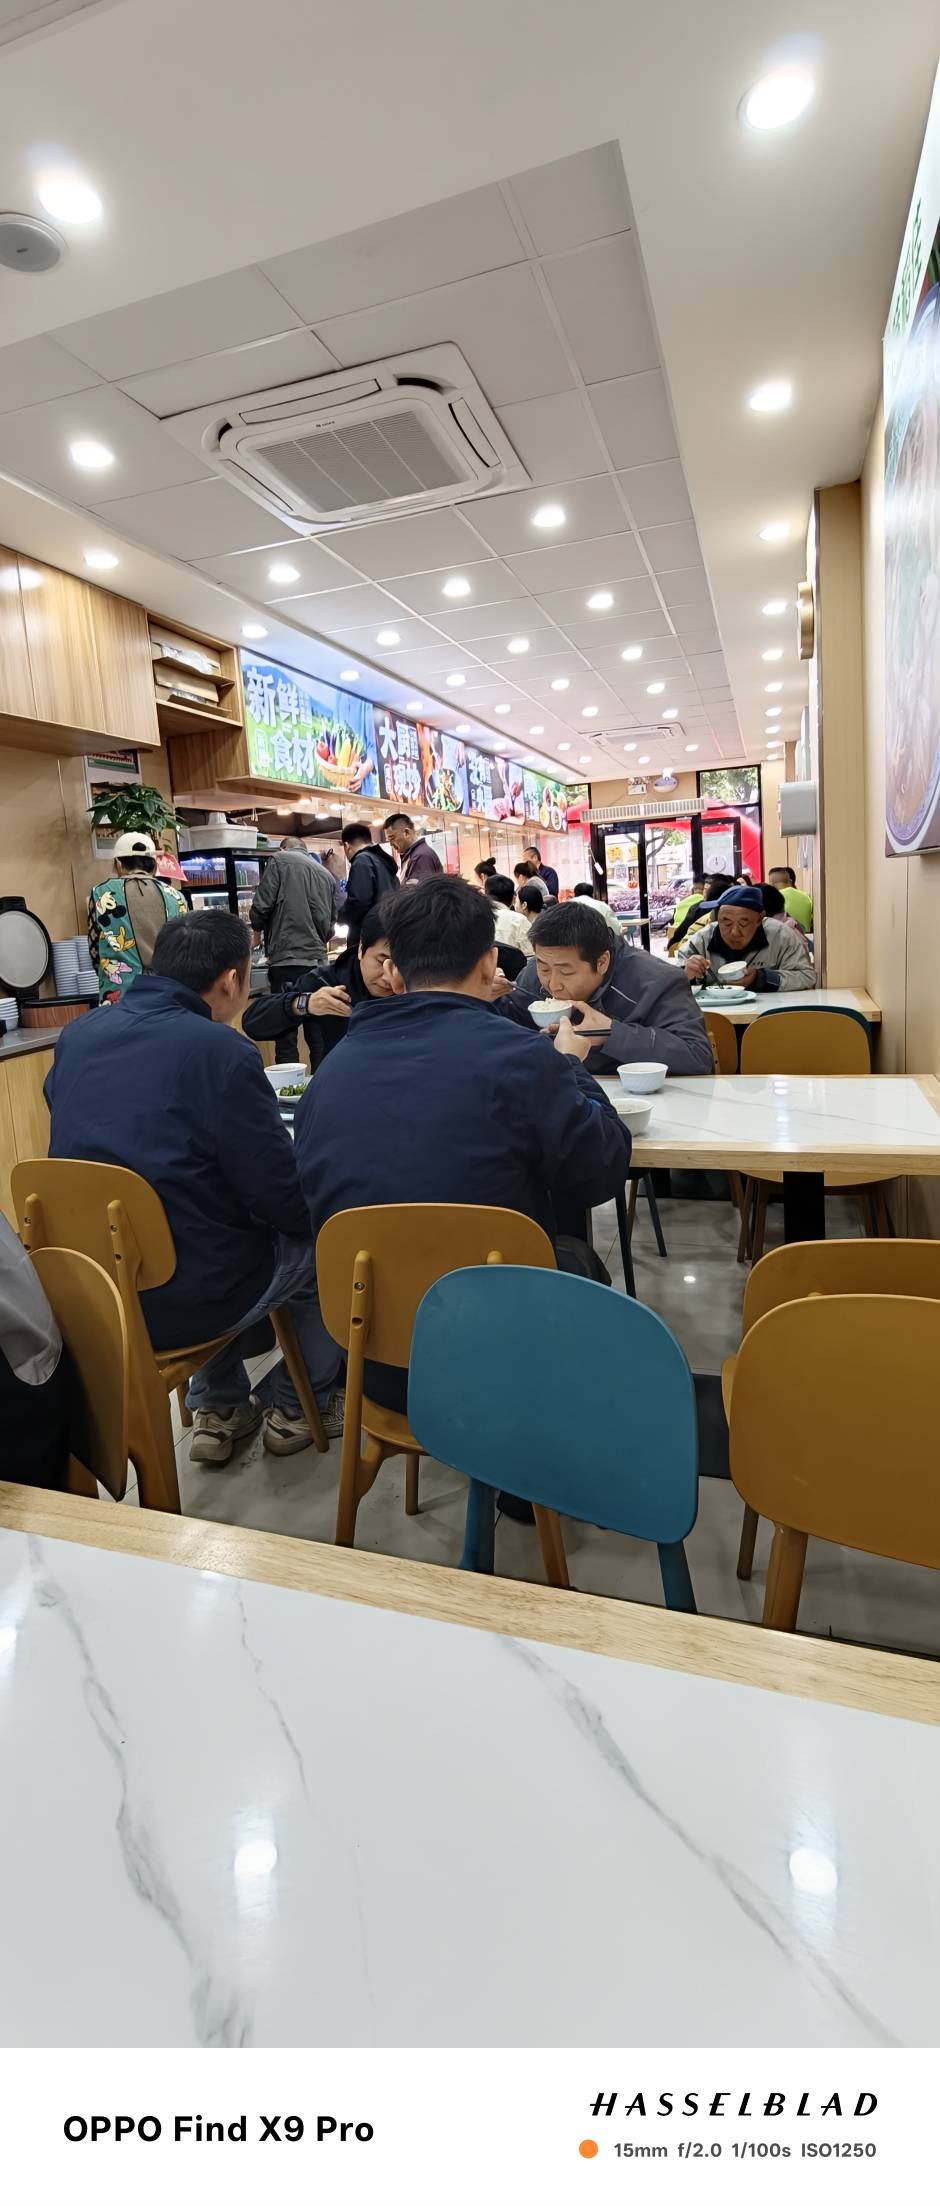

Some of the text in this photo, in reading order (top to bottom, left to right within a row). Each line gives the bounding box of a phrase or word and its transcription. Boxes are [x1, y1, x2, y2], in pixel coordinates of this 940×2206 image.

[246, 666, 299, 728] 新鲜
[271, 728, 317, 779] 食材
[379, 716, 411, 761] 大厨
